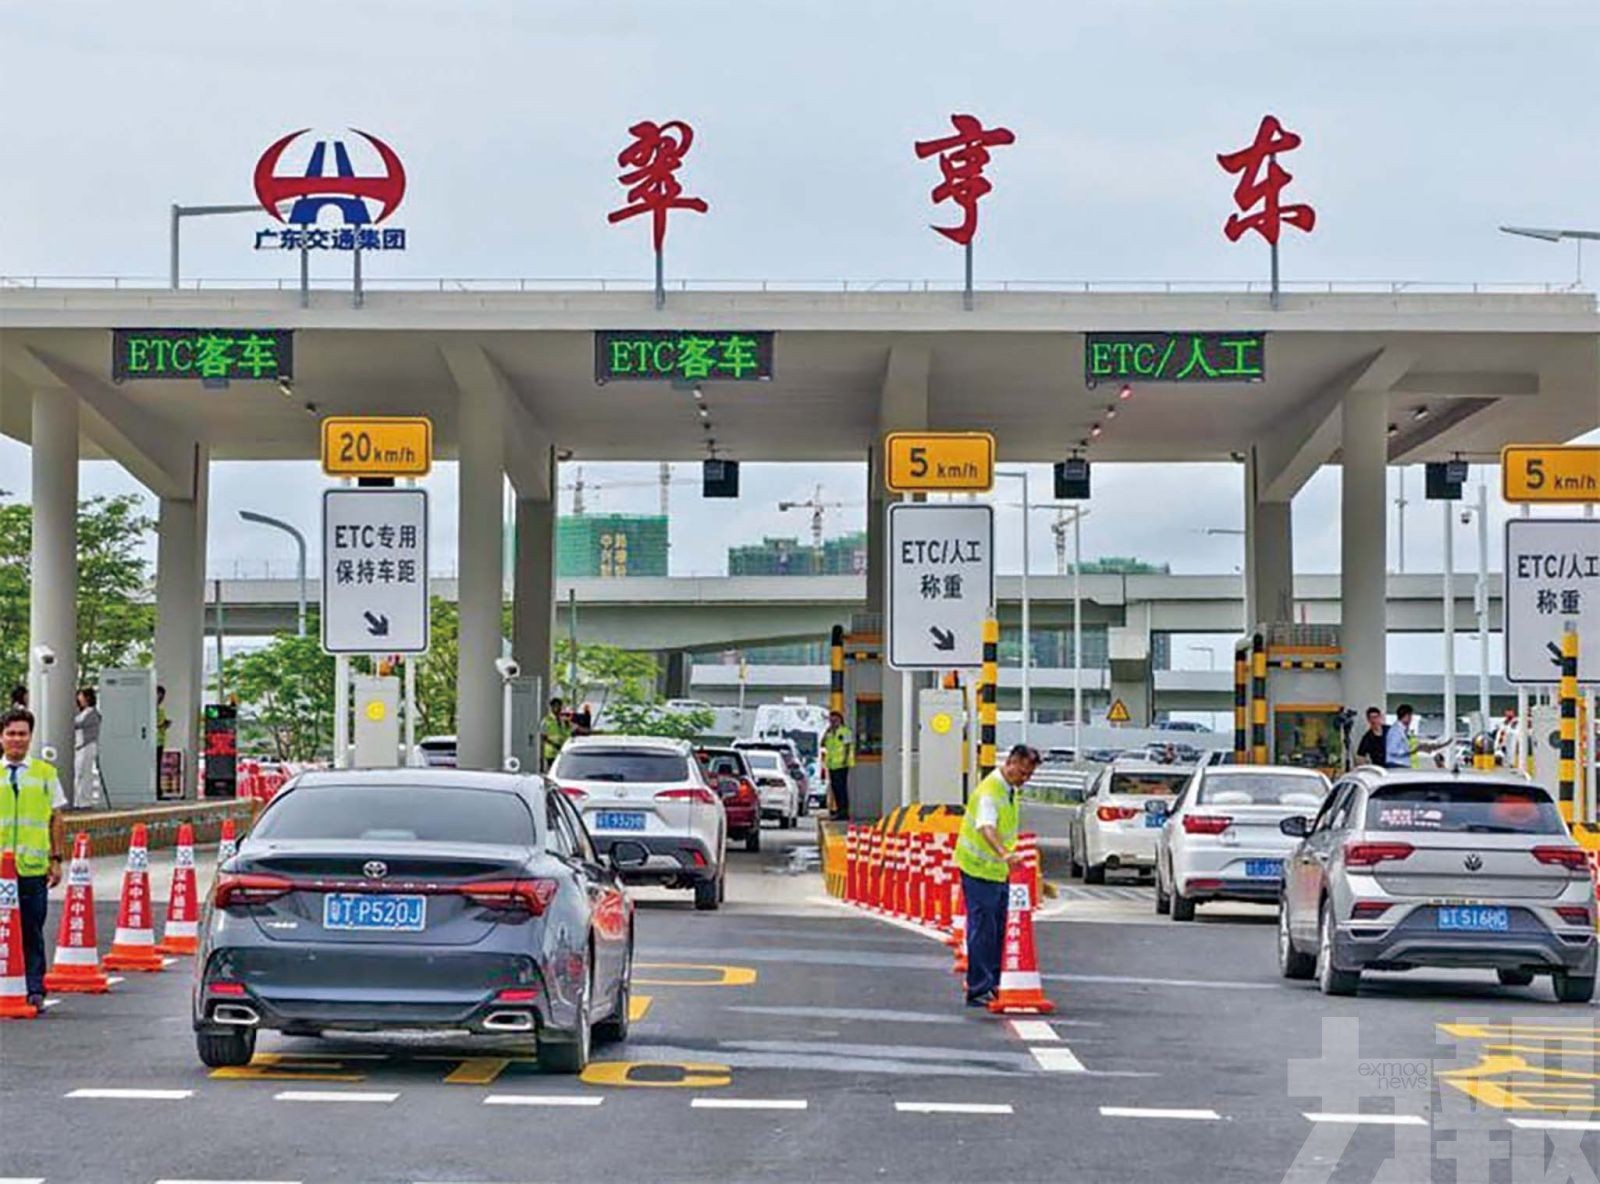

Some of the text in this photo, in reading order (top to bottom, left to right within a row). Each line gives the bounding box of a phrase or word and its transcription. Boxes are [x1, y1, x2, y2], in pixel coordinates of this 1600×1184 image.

[254, 229, 406, 250] 广东交通集团
[128, 336, 279, 377] ETC客车
[610, 337, 759, 378] ETC客车
[1090, 339, 1261, 379] ETC/人工
[910, 447, 979, 479] 5 km/h
[1526, 459, 1596, 490] 5 km/h
[335, 525, 417, 549] ETC专用
[902, 539, 981, 564] ETC/人工
[336, 559, 416, 584] 保持车距
[1517, 554, 1600, 579] ETC/人工
[920, 573, 963, 599] 称重
[1536, 588, 1581, 614] 称重
